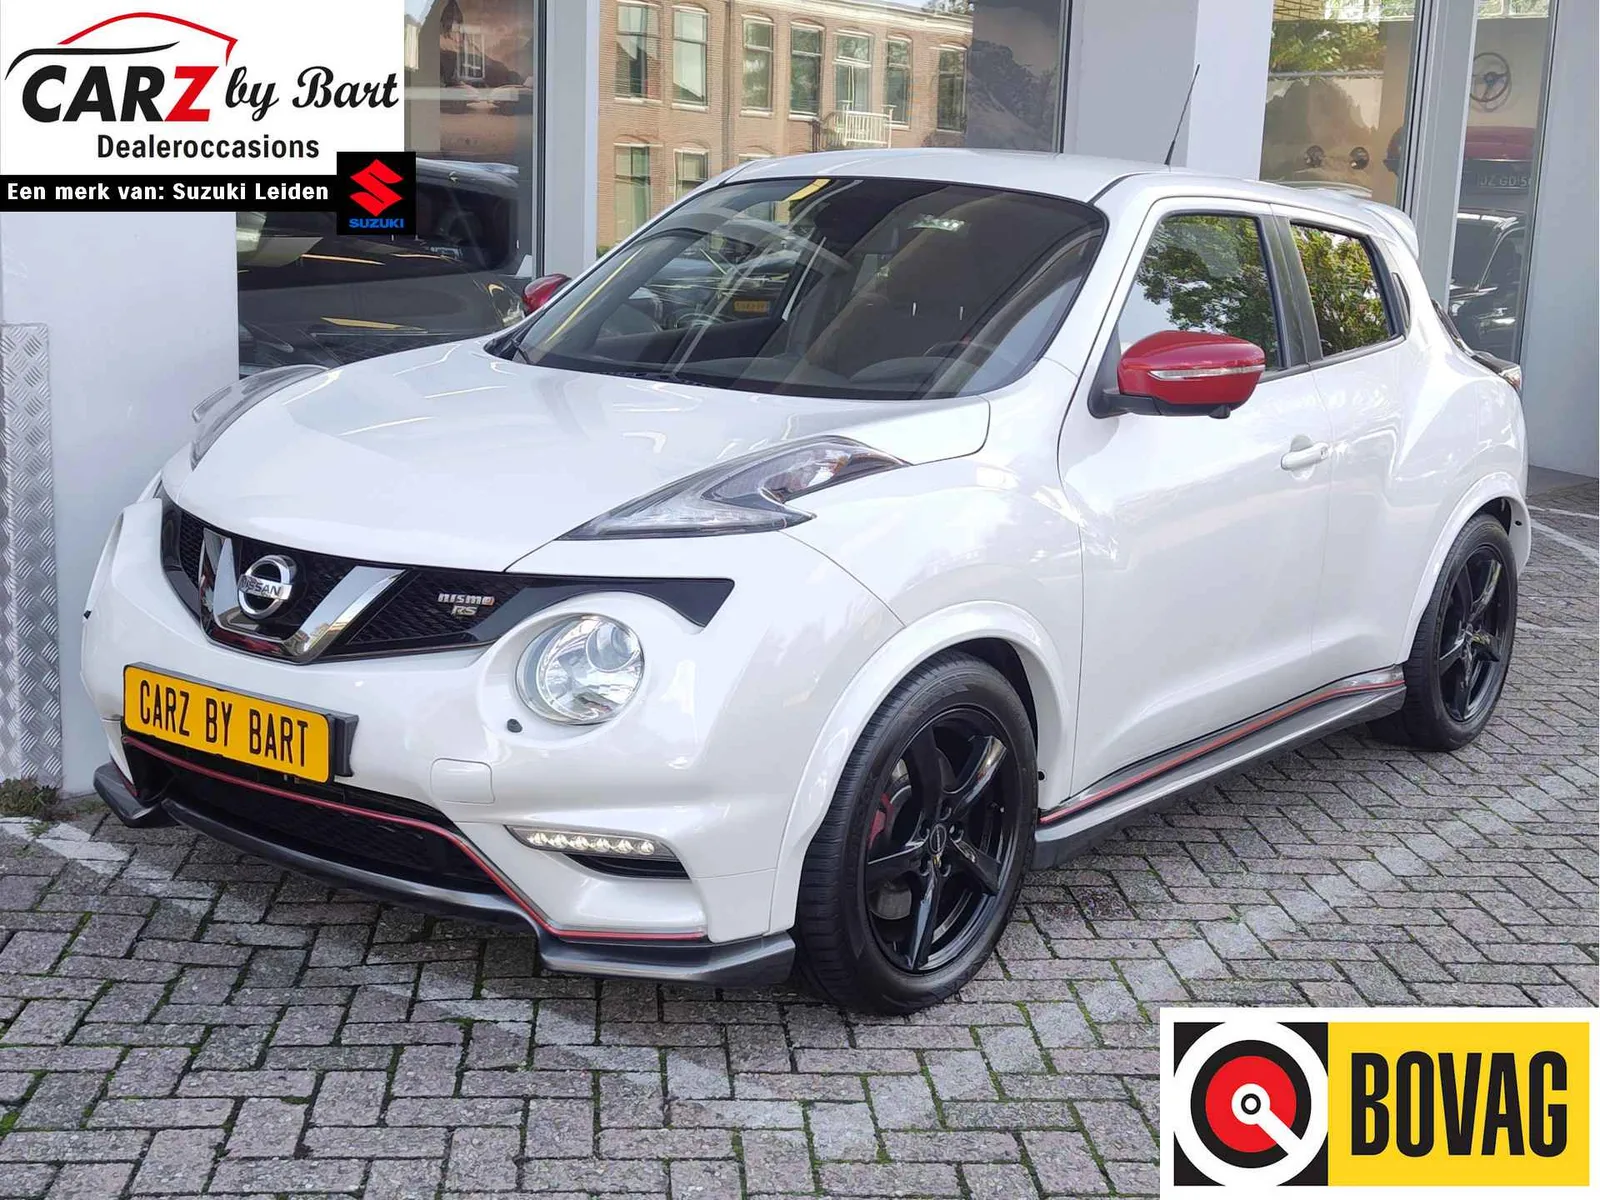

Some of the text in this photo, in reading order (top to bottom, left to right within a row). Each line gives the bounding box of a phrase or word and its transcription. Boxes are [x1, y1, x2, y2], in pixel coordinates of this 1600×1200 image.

[240, 576, 281, 596] NISSAN
[451, 605, 478, 617] RS
[139, 679, 309, 768] CARZ BY BART
